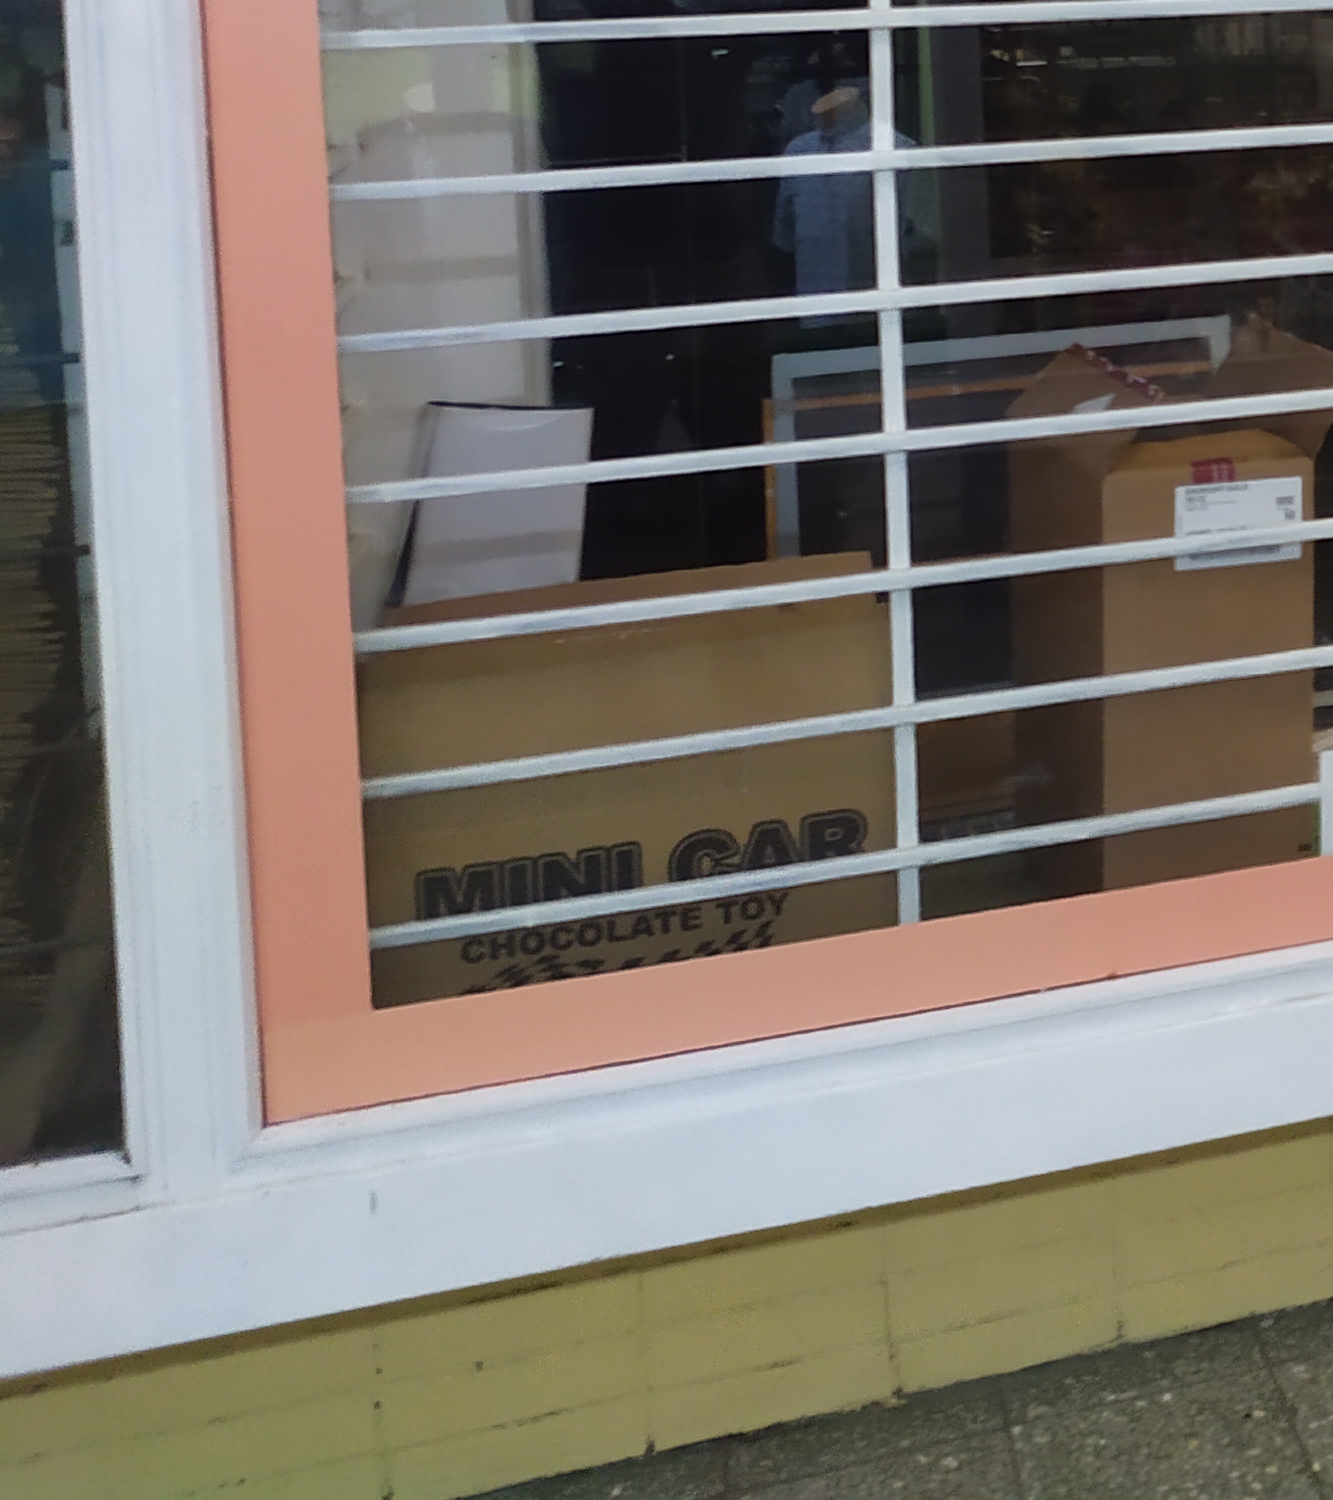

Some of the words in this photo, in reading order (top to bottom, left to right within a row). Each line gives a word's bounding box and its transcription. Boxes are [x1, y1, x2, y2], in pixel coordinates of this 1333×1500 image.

[414, 840, 644, 919] MINI
[668, 808, 868, 882] CAR
[460, 906, 702, 965] CHOCOLATE
[715, 892, 790, 924] TOY
